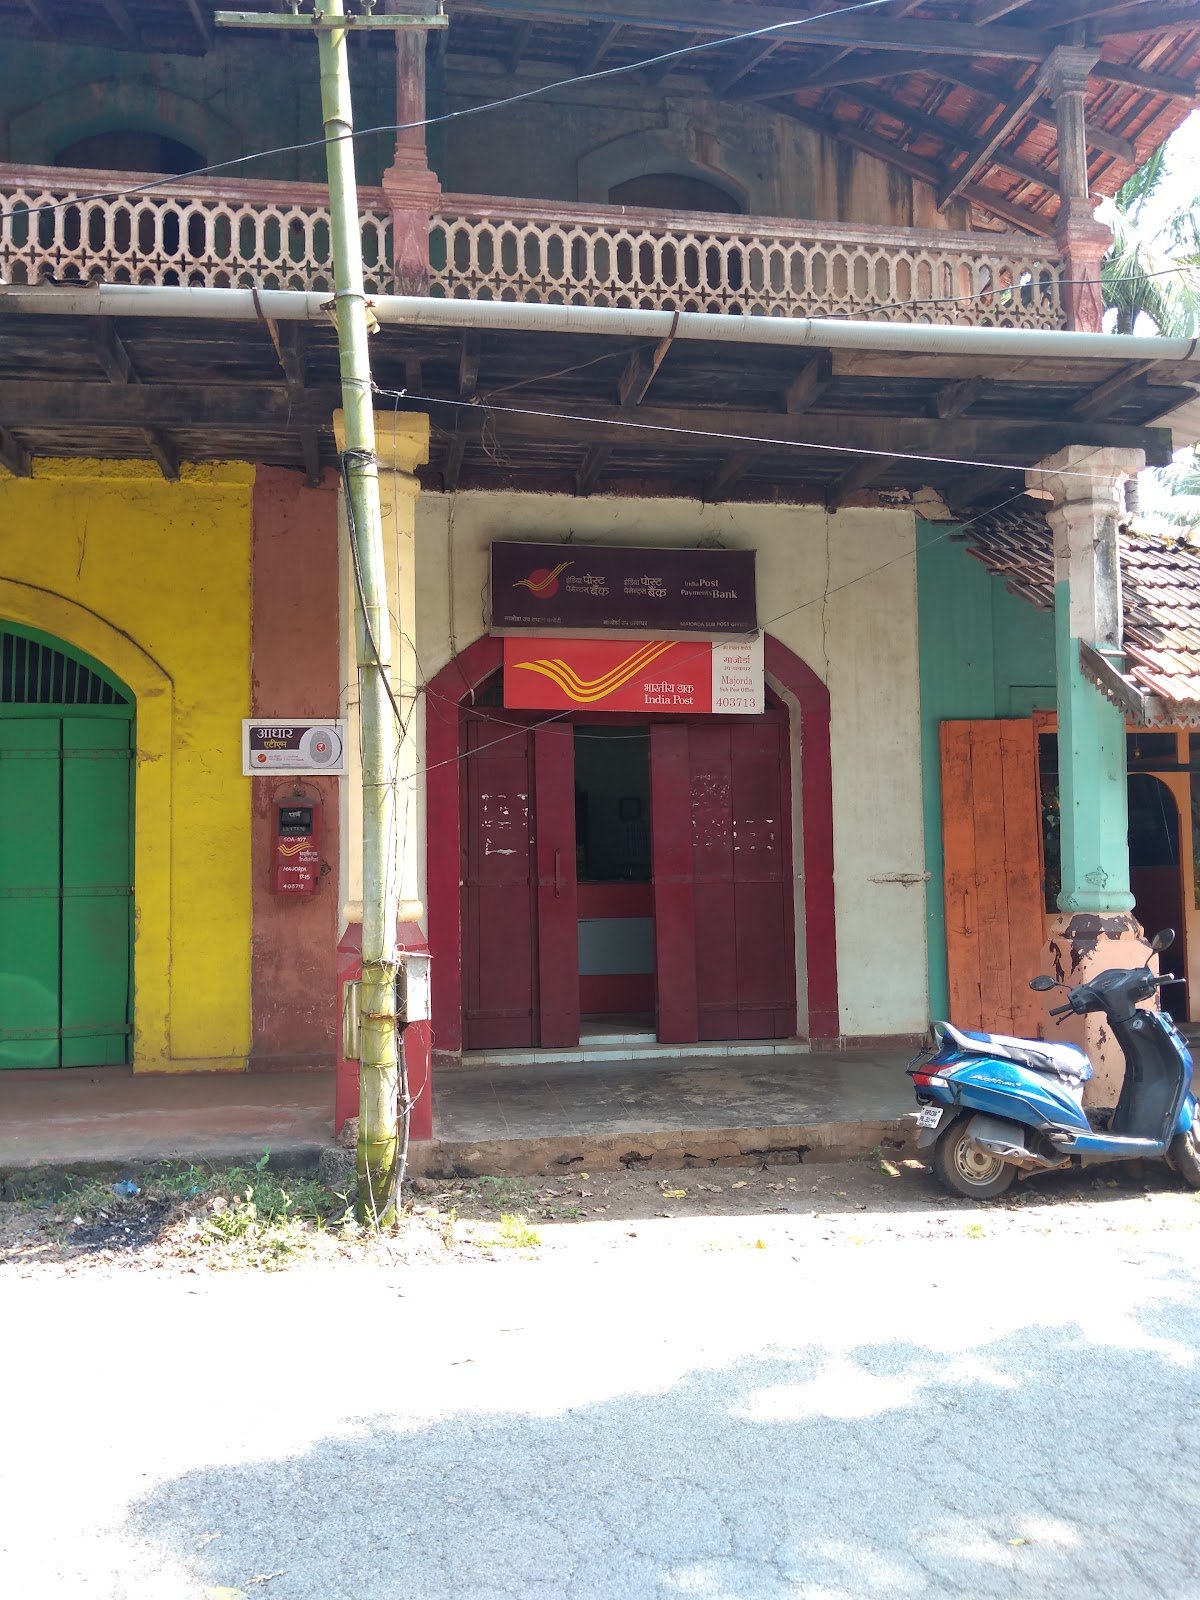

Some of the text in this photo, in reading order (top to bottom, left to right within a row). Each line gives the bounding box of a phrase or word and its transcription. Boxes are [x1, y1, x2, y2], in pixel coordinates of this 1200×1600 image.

[583, 573, 606, 585] पोस्ट
[640, 575, 663, 586] पोस्ट
[699, 578, 719, 588] Post
[712, 589, 738, 599] Bank
[721, 675, 753, 687] Majorda
[643, 681, 695, 693] भारतीय डाक
[644, 694, 694, 705] India Post
[716, 697, 756, 708] 403713
[256, 728, 294, 739] आधार
[263, 739, 287, 749] एटीएम
